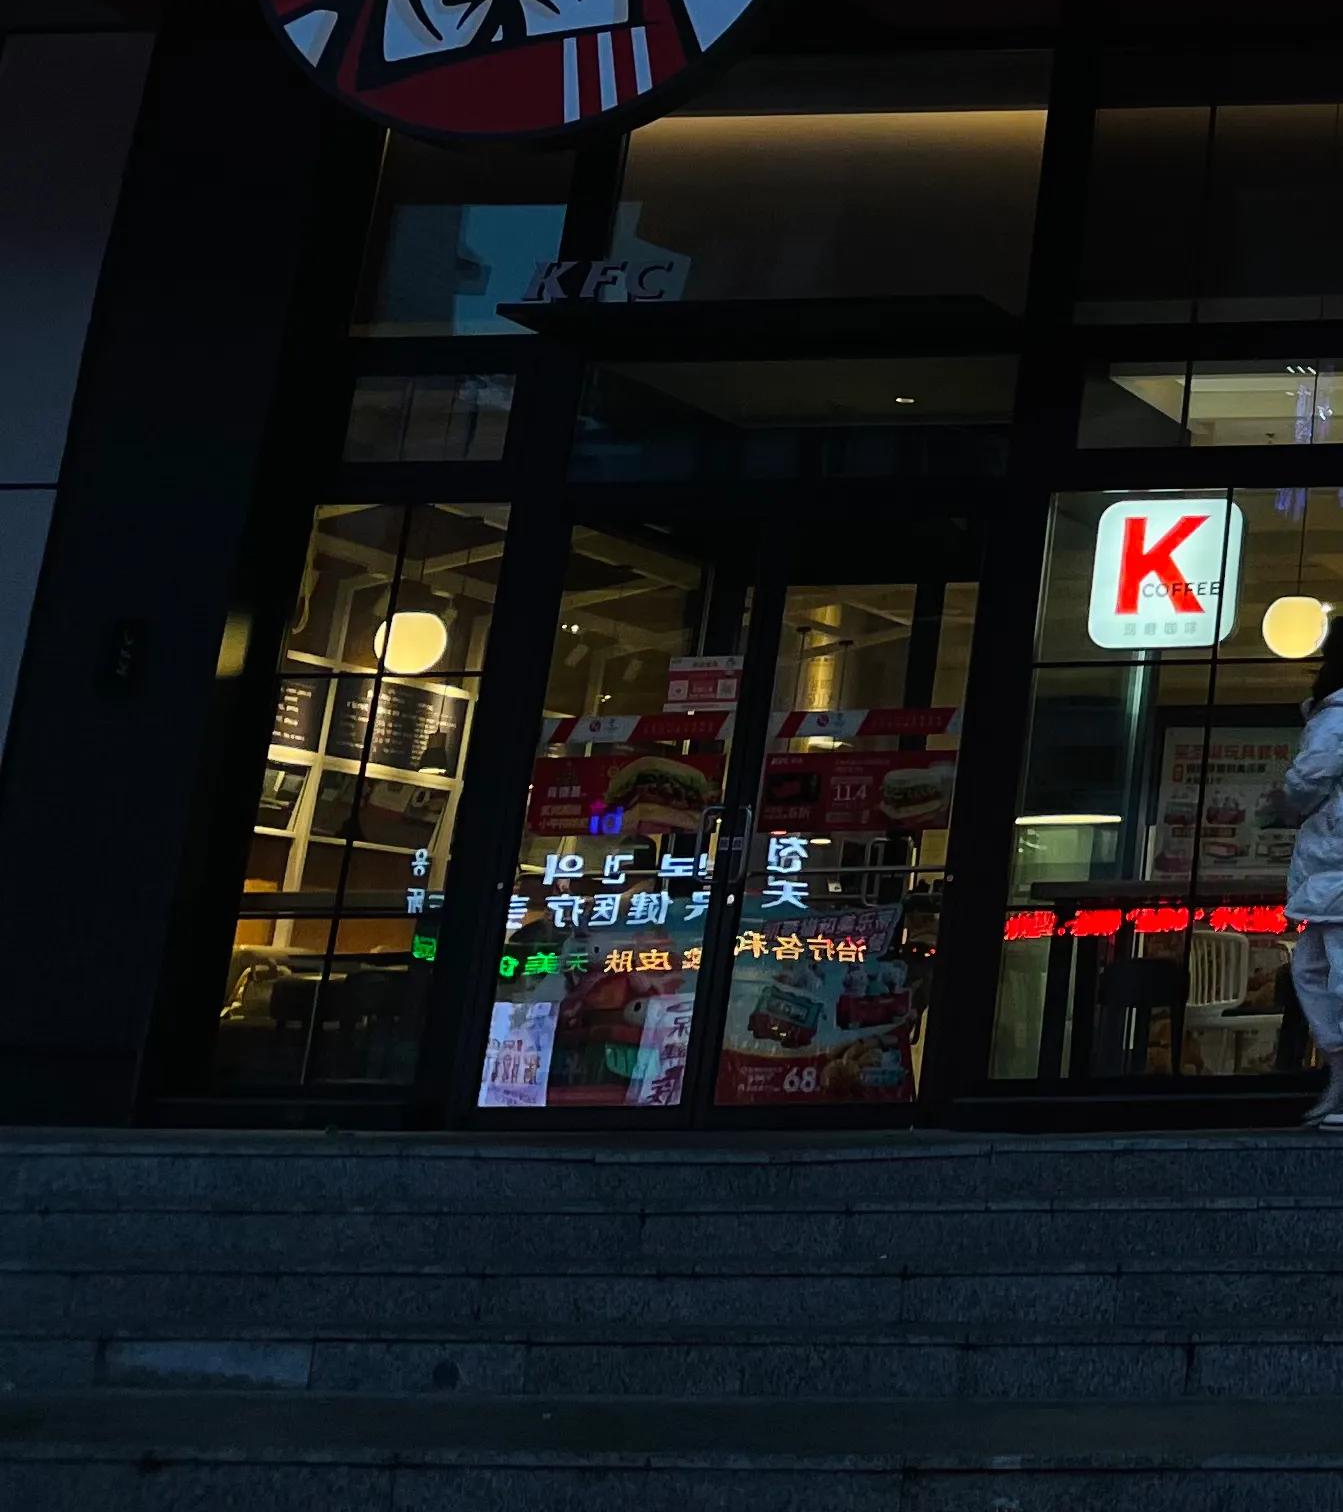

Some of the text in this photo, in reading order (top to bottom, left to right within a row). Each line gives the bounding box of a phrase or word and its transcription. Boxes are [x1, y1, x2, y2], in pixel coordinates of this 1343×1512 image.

[521, 257, 678, 302] KFC
[1114, 514, 1211, 615] K
[1142, 581, 1222, 598] COFFEE
[782, 1066, 818, 1094] 68
